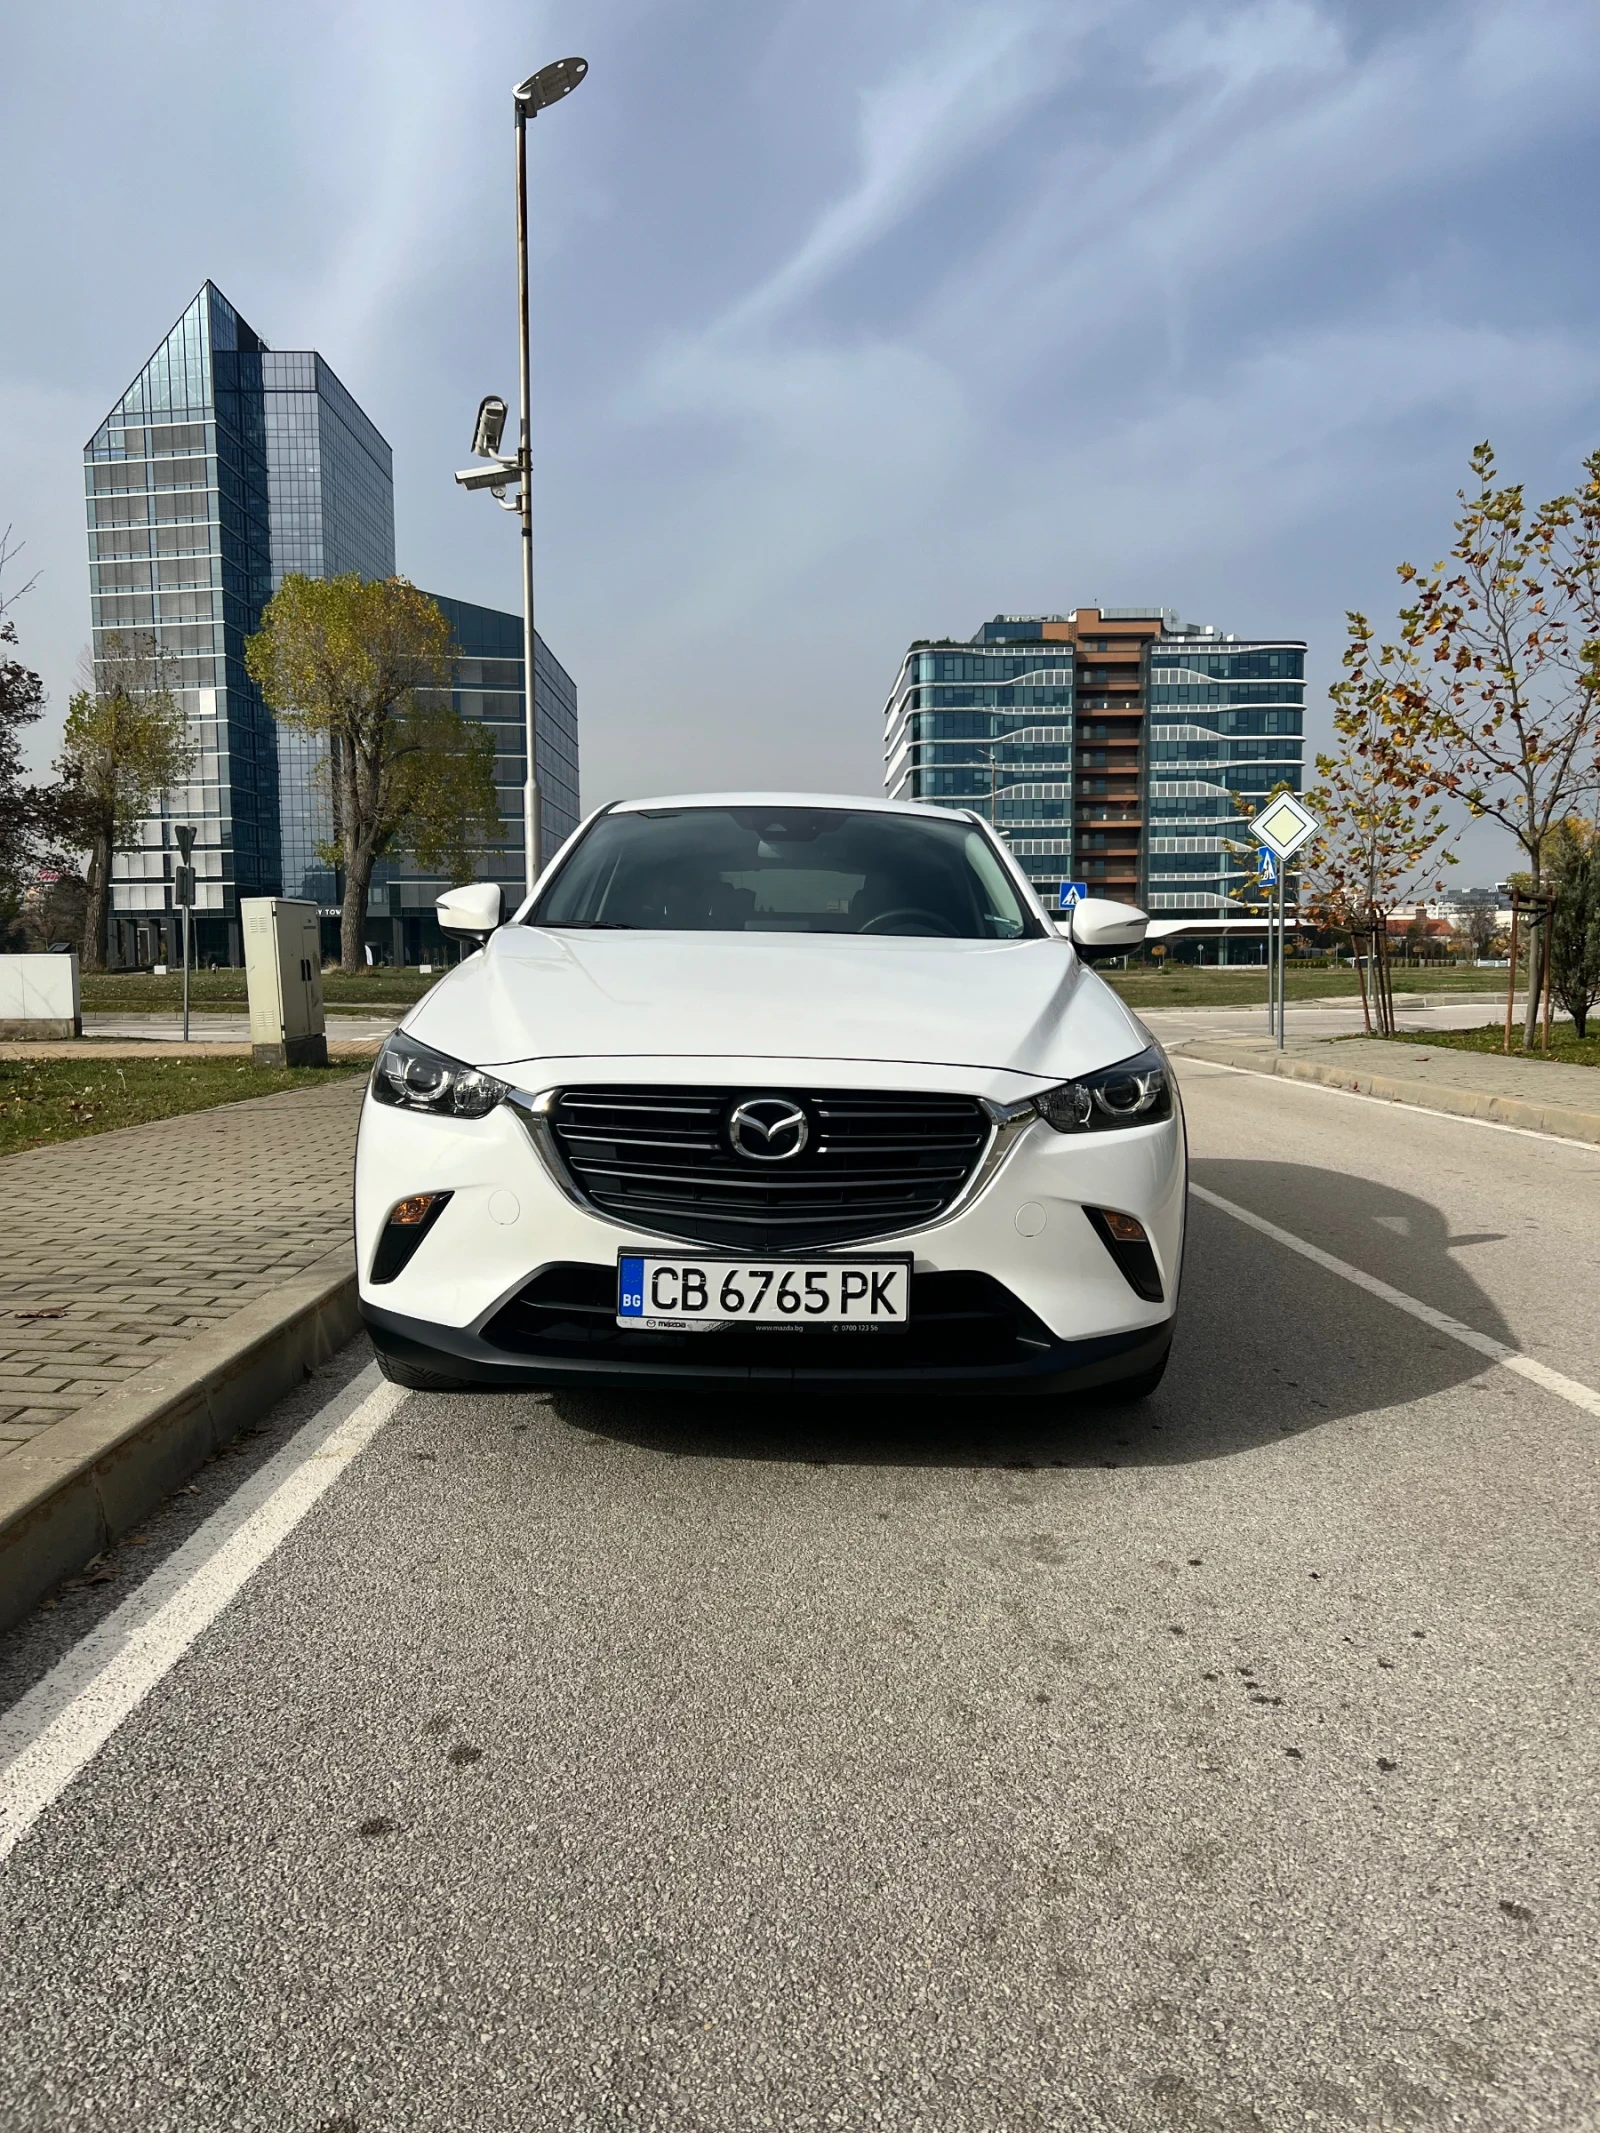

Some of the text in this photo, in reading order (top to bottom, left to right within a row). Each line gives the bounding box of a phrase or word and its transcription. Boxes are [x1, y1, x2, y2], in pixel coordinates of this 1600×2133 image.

[652, 1267, 897, 1315] CB 6765 PK
[623, 1294, 641, 1307] BG
[841, 1324, 878, 1332] 0700 123 56
